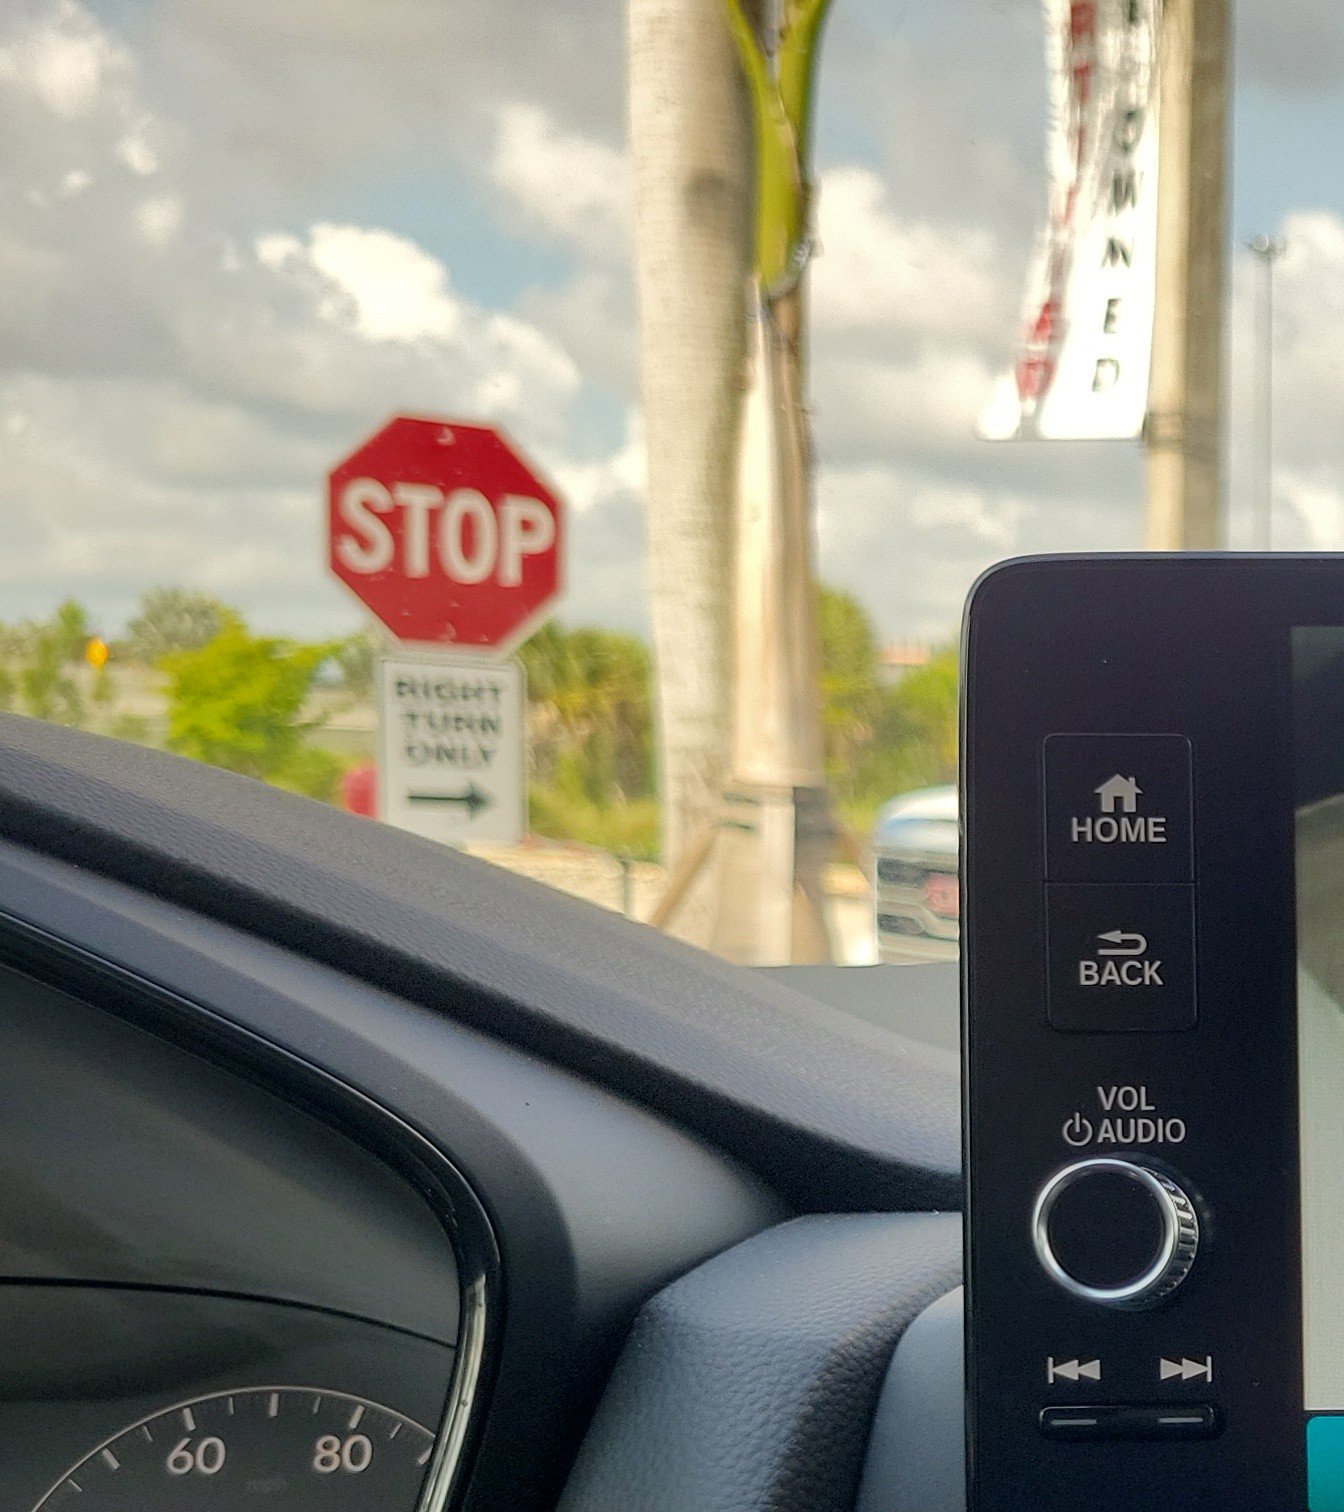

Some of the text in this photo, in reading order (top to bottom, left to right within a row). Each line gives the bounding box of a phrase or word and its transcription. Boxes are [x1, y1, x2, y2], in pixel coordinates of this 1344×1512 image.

[338, 478, 556, 588] STOP
[396, 679, 502, 701] RIGHT
[405, 711, 500, 735] TURN
[406, 744, 496, 768] ONLY
[1072, 818, 1166, 843] HOME
[1080, 961, 1163, 987] BACK
[1098, 1087, 1155, 1112] VOL
[1097, 1118, 1186, 1144] AUDIO
[166, 1437, 226, 1475] 60
[313, 1435, 374, 1473] 80
